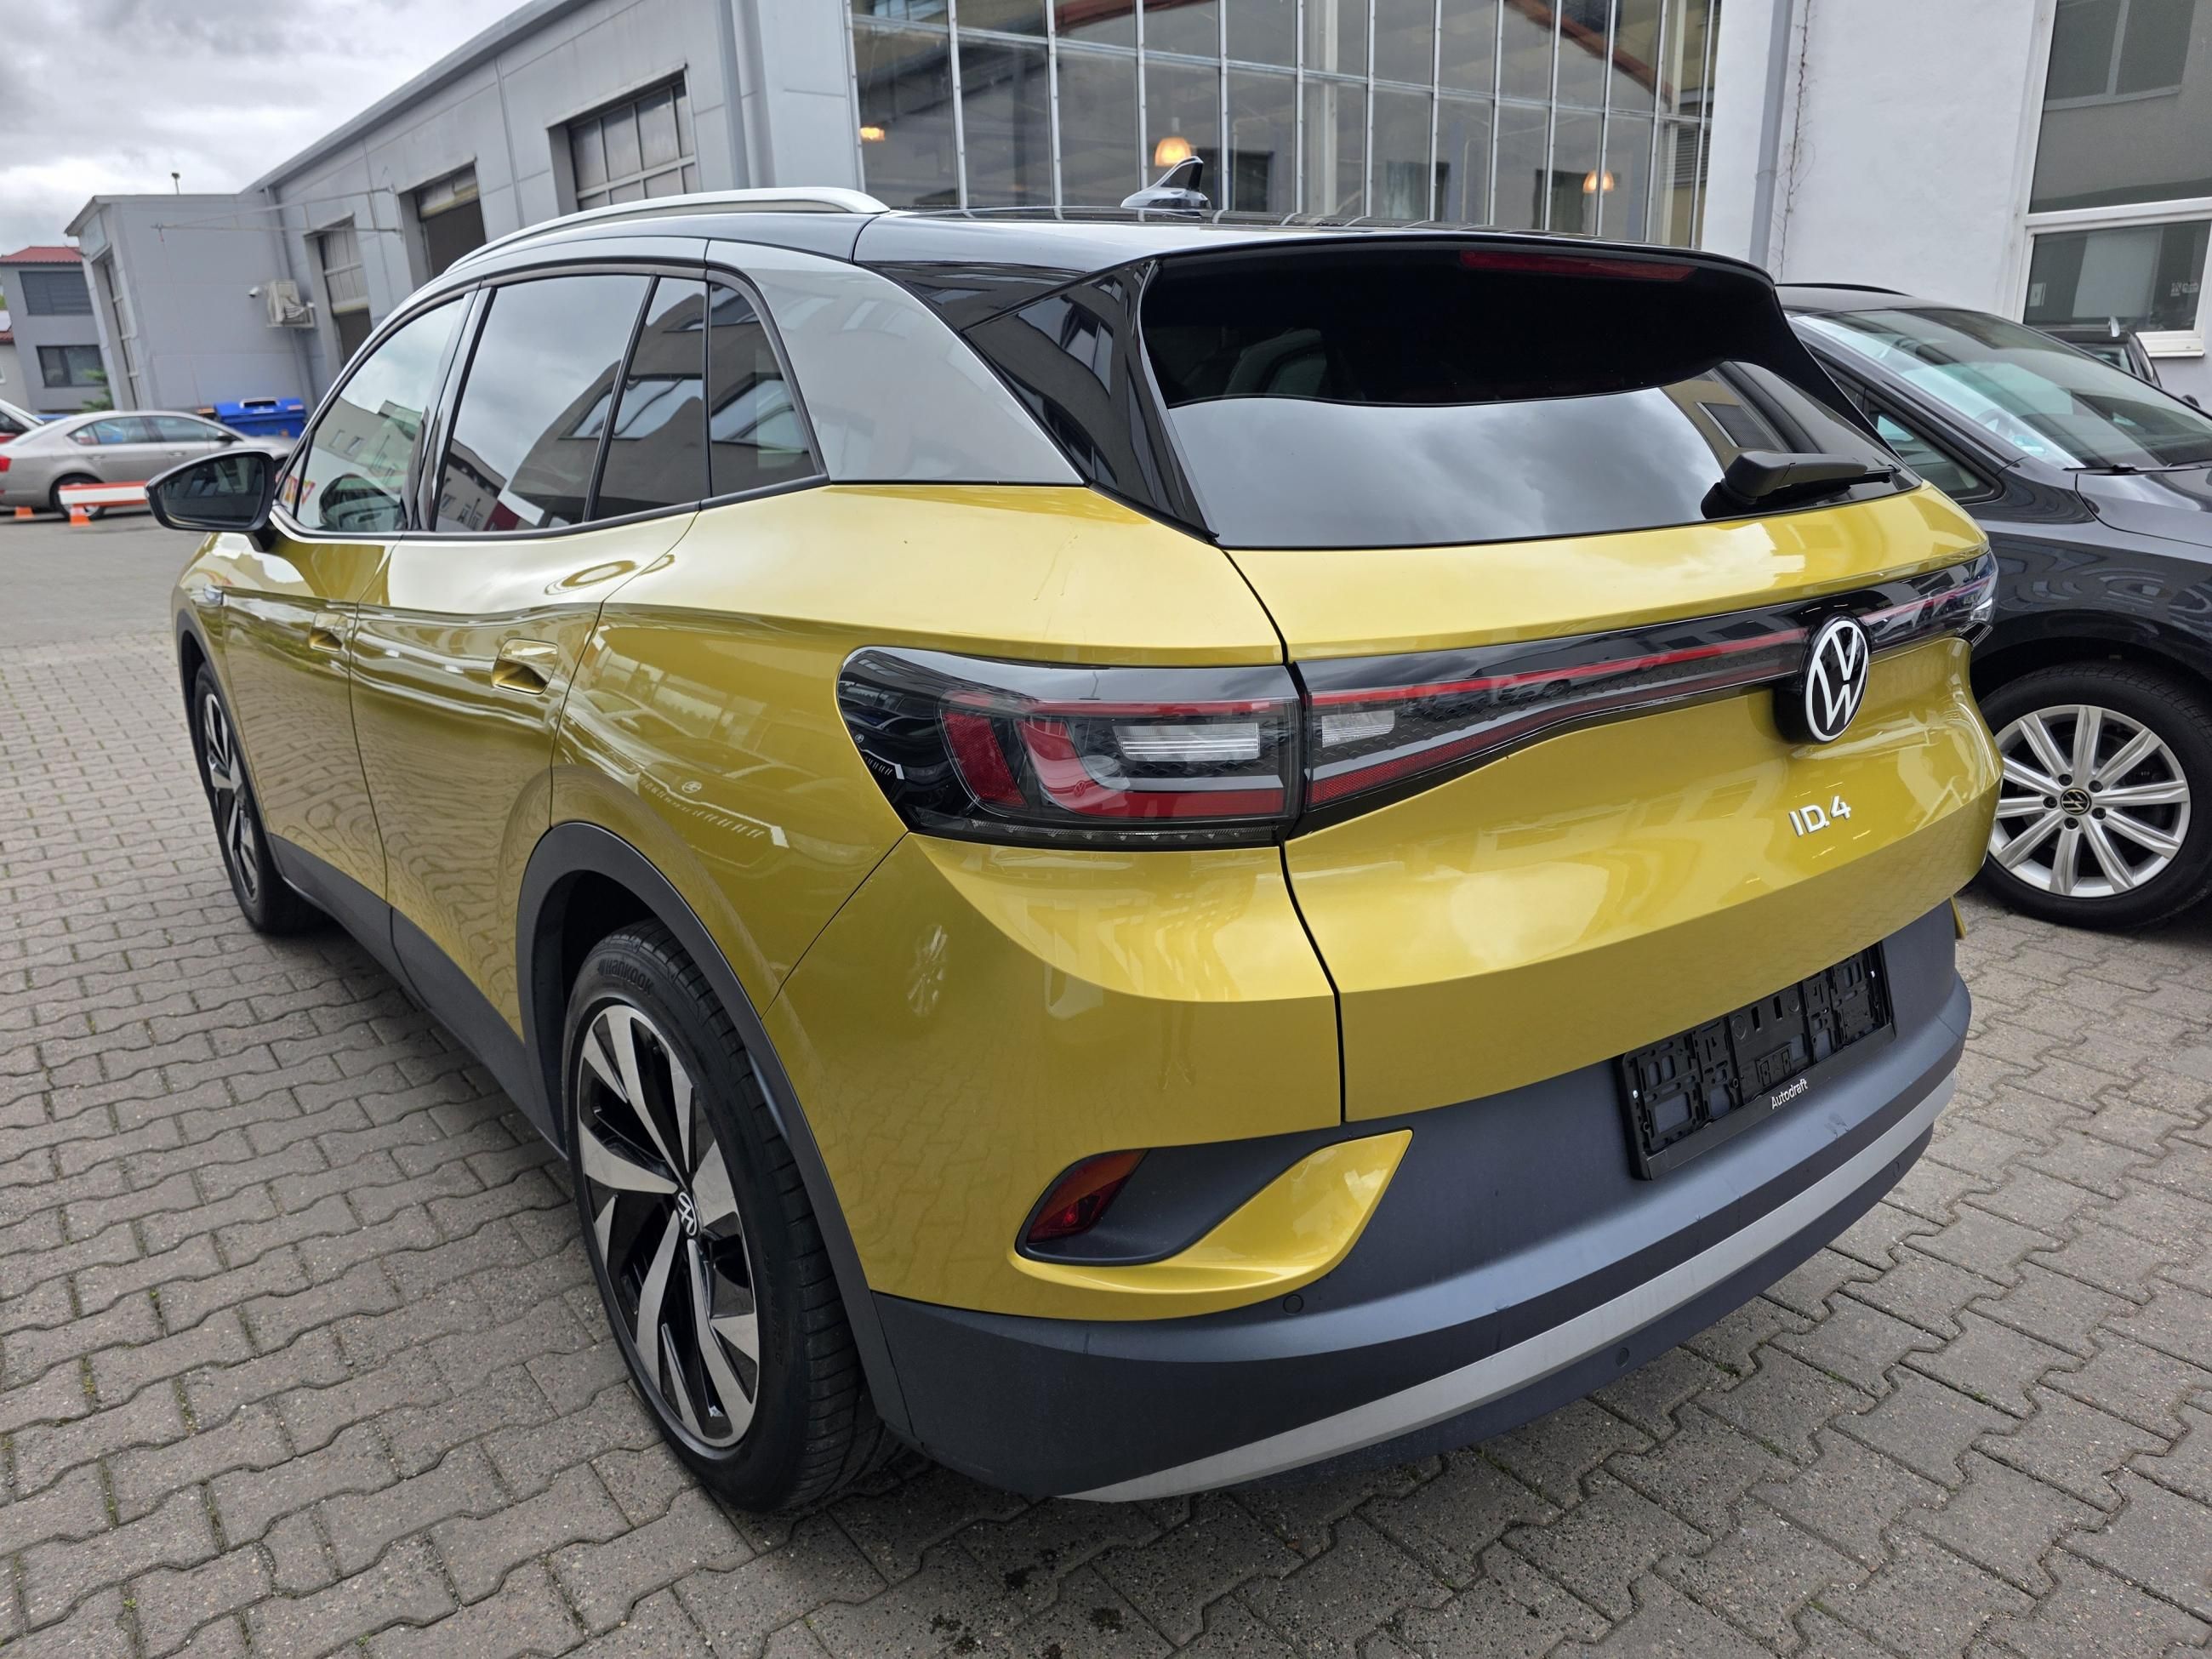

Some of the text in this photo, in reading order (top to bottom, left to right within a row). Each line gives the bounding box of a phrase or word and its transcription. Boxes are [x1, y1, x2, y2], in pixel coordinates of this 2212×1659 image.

[1805, 620, 1868, 742] VW
[605, 959, 653, 995] Hankook
[1771, 1078, 1808, 1110] Autodraft
